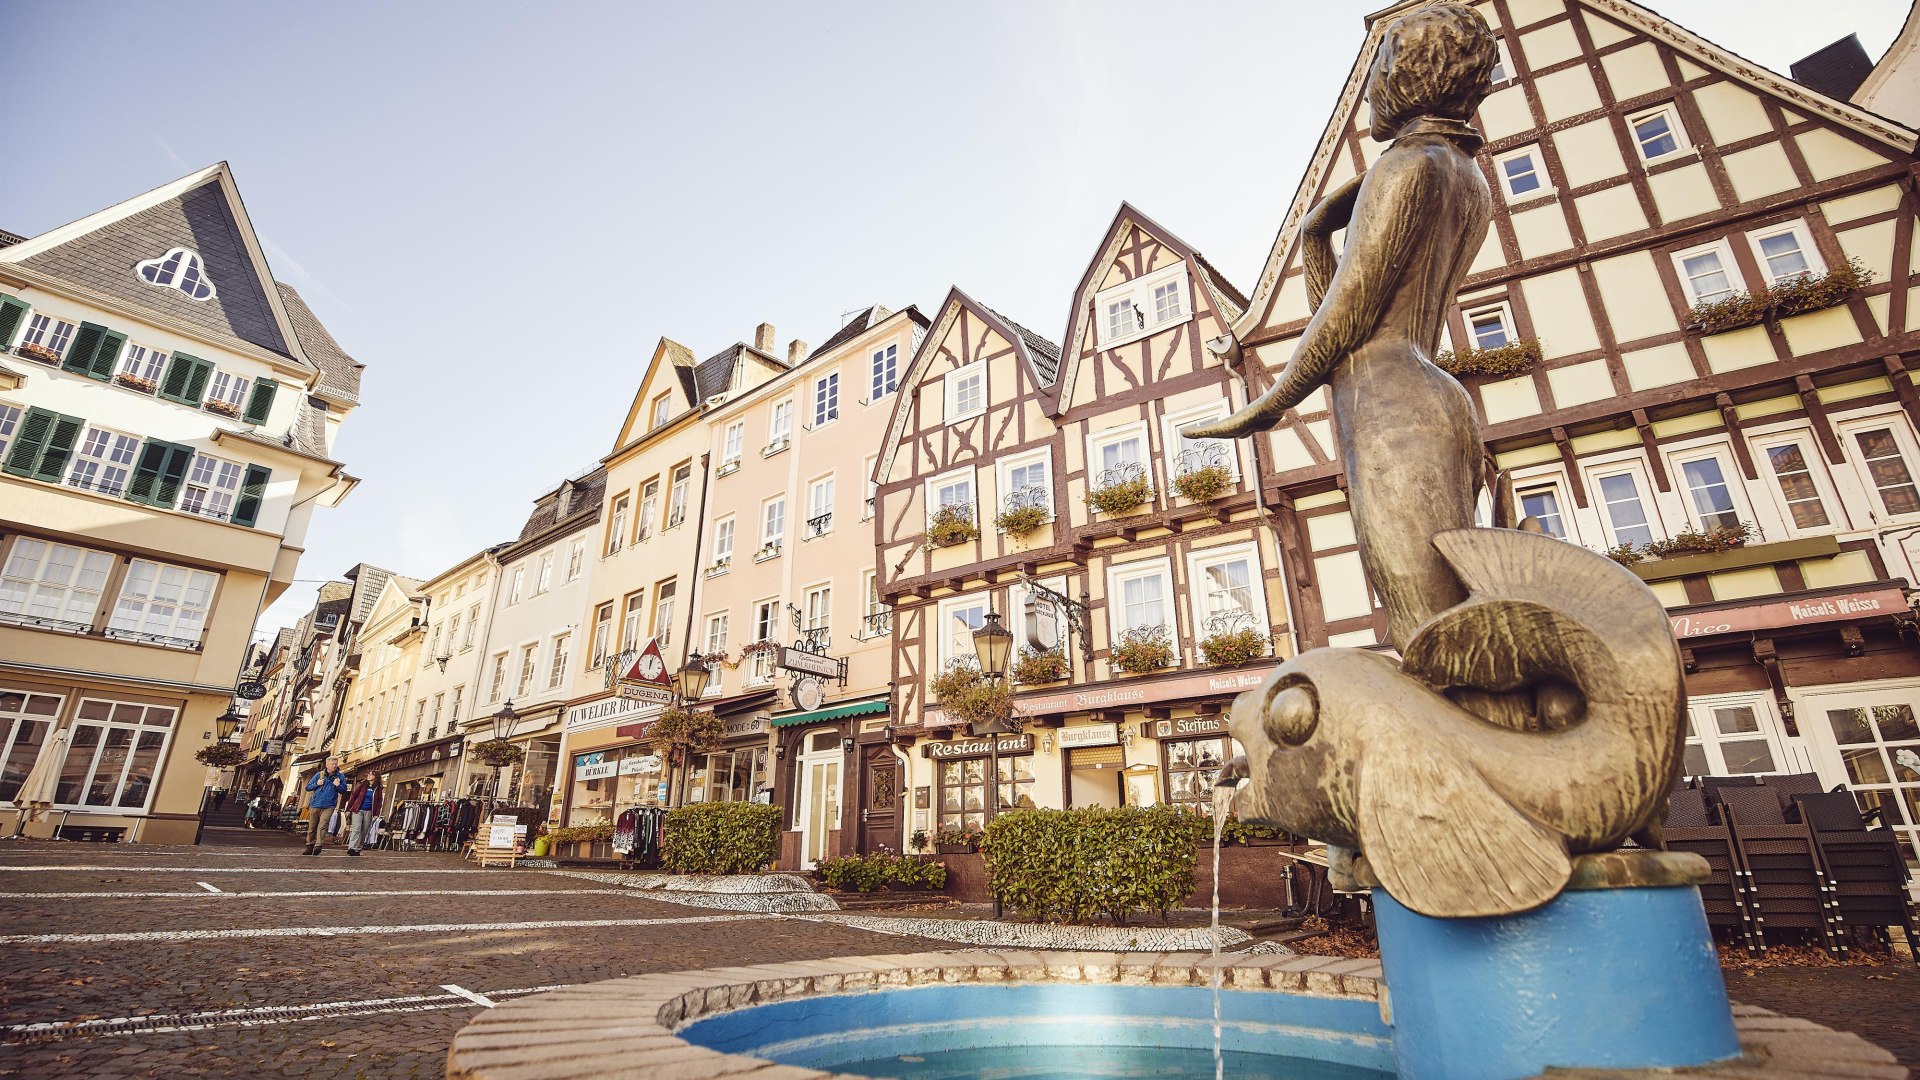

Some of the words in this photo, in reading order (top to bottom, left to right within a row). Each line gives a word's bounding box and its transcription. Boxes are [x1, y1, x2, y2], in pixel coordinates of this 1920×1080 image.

[1789, 601, 1837, 620] Maisel's
[1836, 598, 1880, 615] Weisse
[1671, 617, 1731, 637] Nico
[1210, 676, 1237, 691] Maisel's
[1237, 674, 1262, 688] Weisse
[623, 687, 669, 700] DUGENA
[1022, 699, 1068, 712] Restaurant
[1074, 690, 1145, 706] Burgklause
[568, 701, 617, 725] JUWELIER
[1176, 717, 1220, 733] Steffens
[1061, 729, 1112, 742] Burgklause
[929, 734, 1028, 757] Restauant
[585, 765, 609, 777] BÜRKLE
